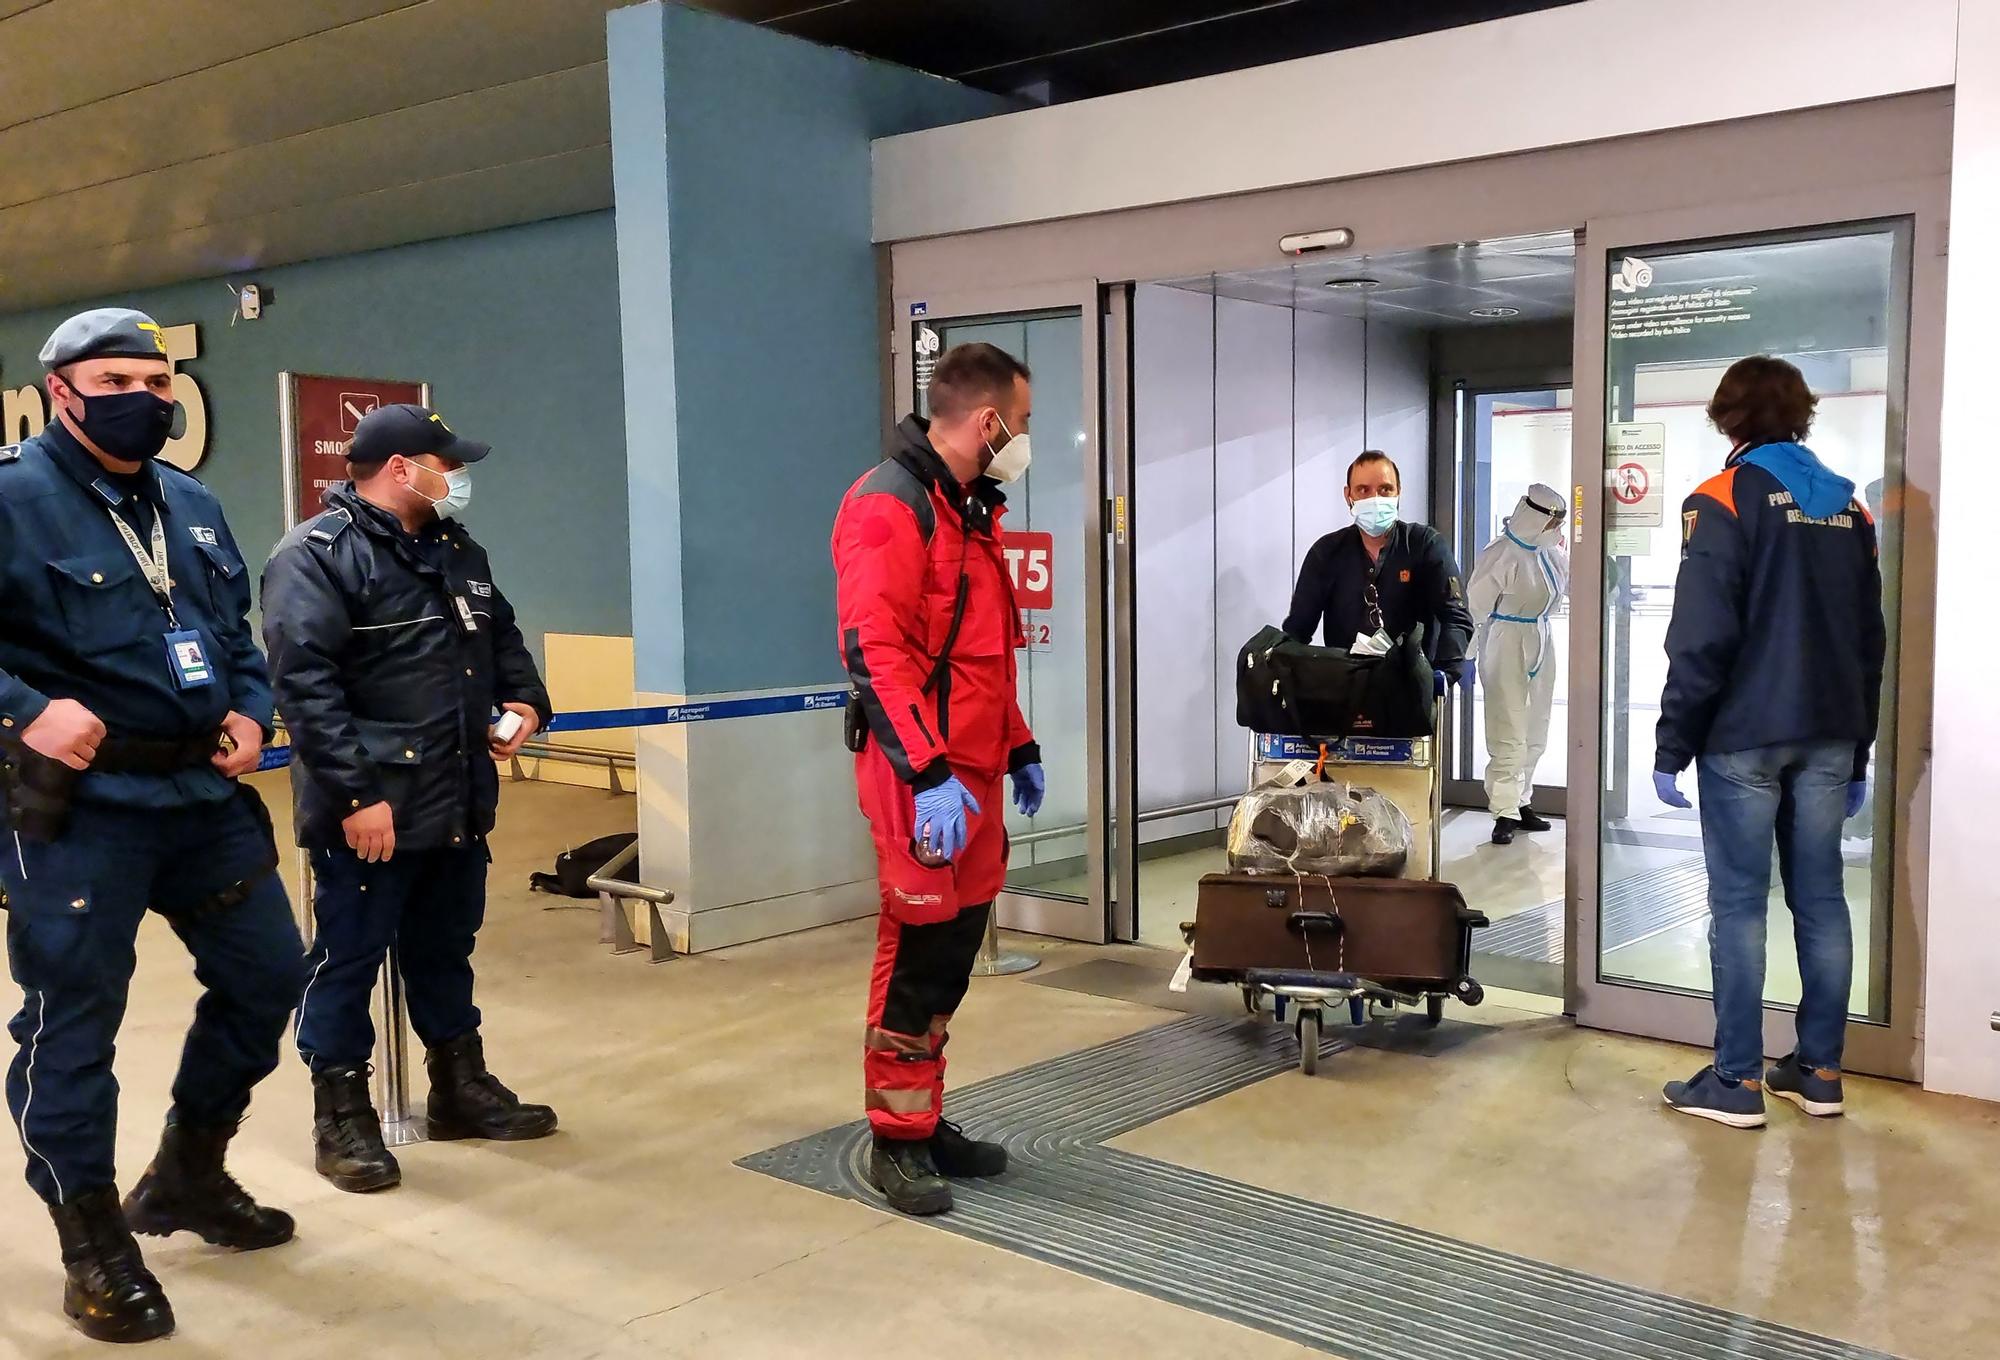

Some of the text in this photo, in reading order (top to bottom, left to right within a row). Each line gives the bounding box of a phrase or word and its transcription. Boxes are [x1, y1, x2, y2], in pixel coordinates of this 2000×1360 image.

[1628, 297, 1644, 305] video
[1626, 321, 1643, 329] under
[1644, 319, 1660, 327] video
[1611, 326, 1692, 339] Video recorded by the Police
[314, 440, 343, 455] SMO
[1768, 491, 1793, 507] PRO
[1003, 549, 1048, 591] T5
[1039, 624, 1050, 644] 2
[680, 705, 710, 714] Aeroporti
